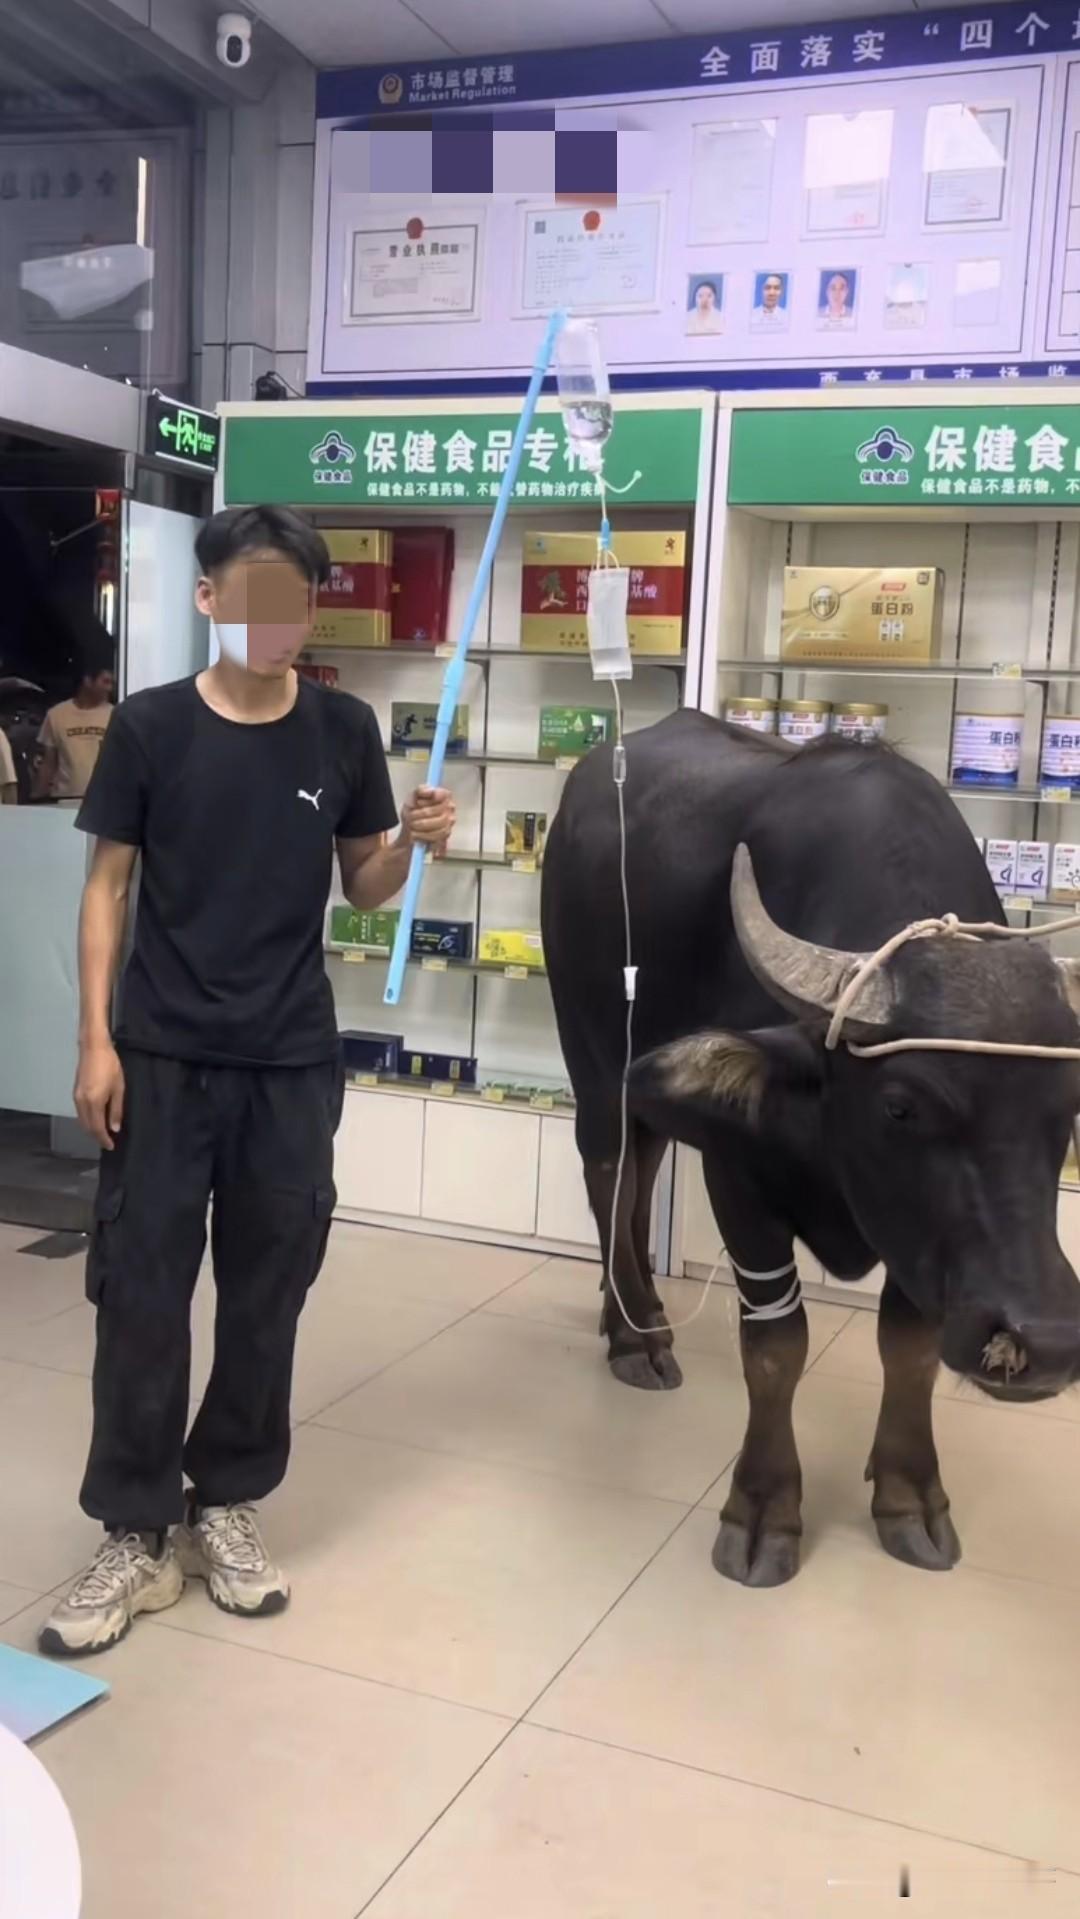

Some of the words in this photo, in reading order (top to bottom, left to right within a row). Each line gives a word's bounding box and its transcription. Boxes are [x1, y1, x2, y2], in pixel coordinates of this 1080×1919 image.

[700, 8, 1080, 77] 全面落实“四个
[410, 65, 514, 90] 市场监督管理
[409, 90, 449, 103] Market
[452, 86, 516, 100] Regulation
[924, 424, 1080, 473] 保健食
[313, 469, 352, 484] 保健食品
[860, 469, 909, 484] 保健食品
[871, 602, 914, 616] 蛋白粉
